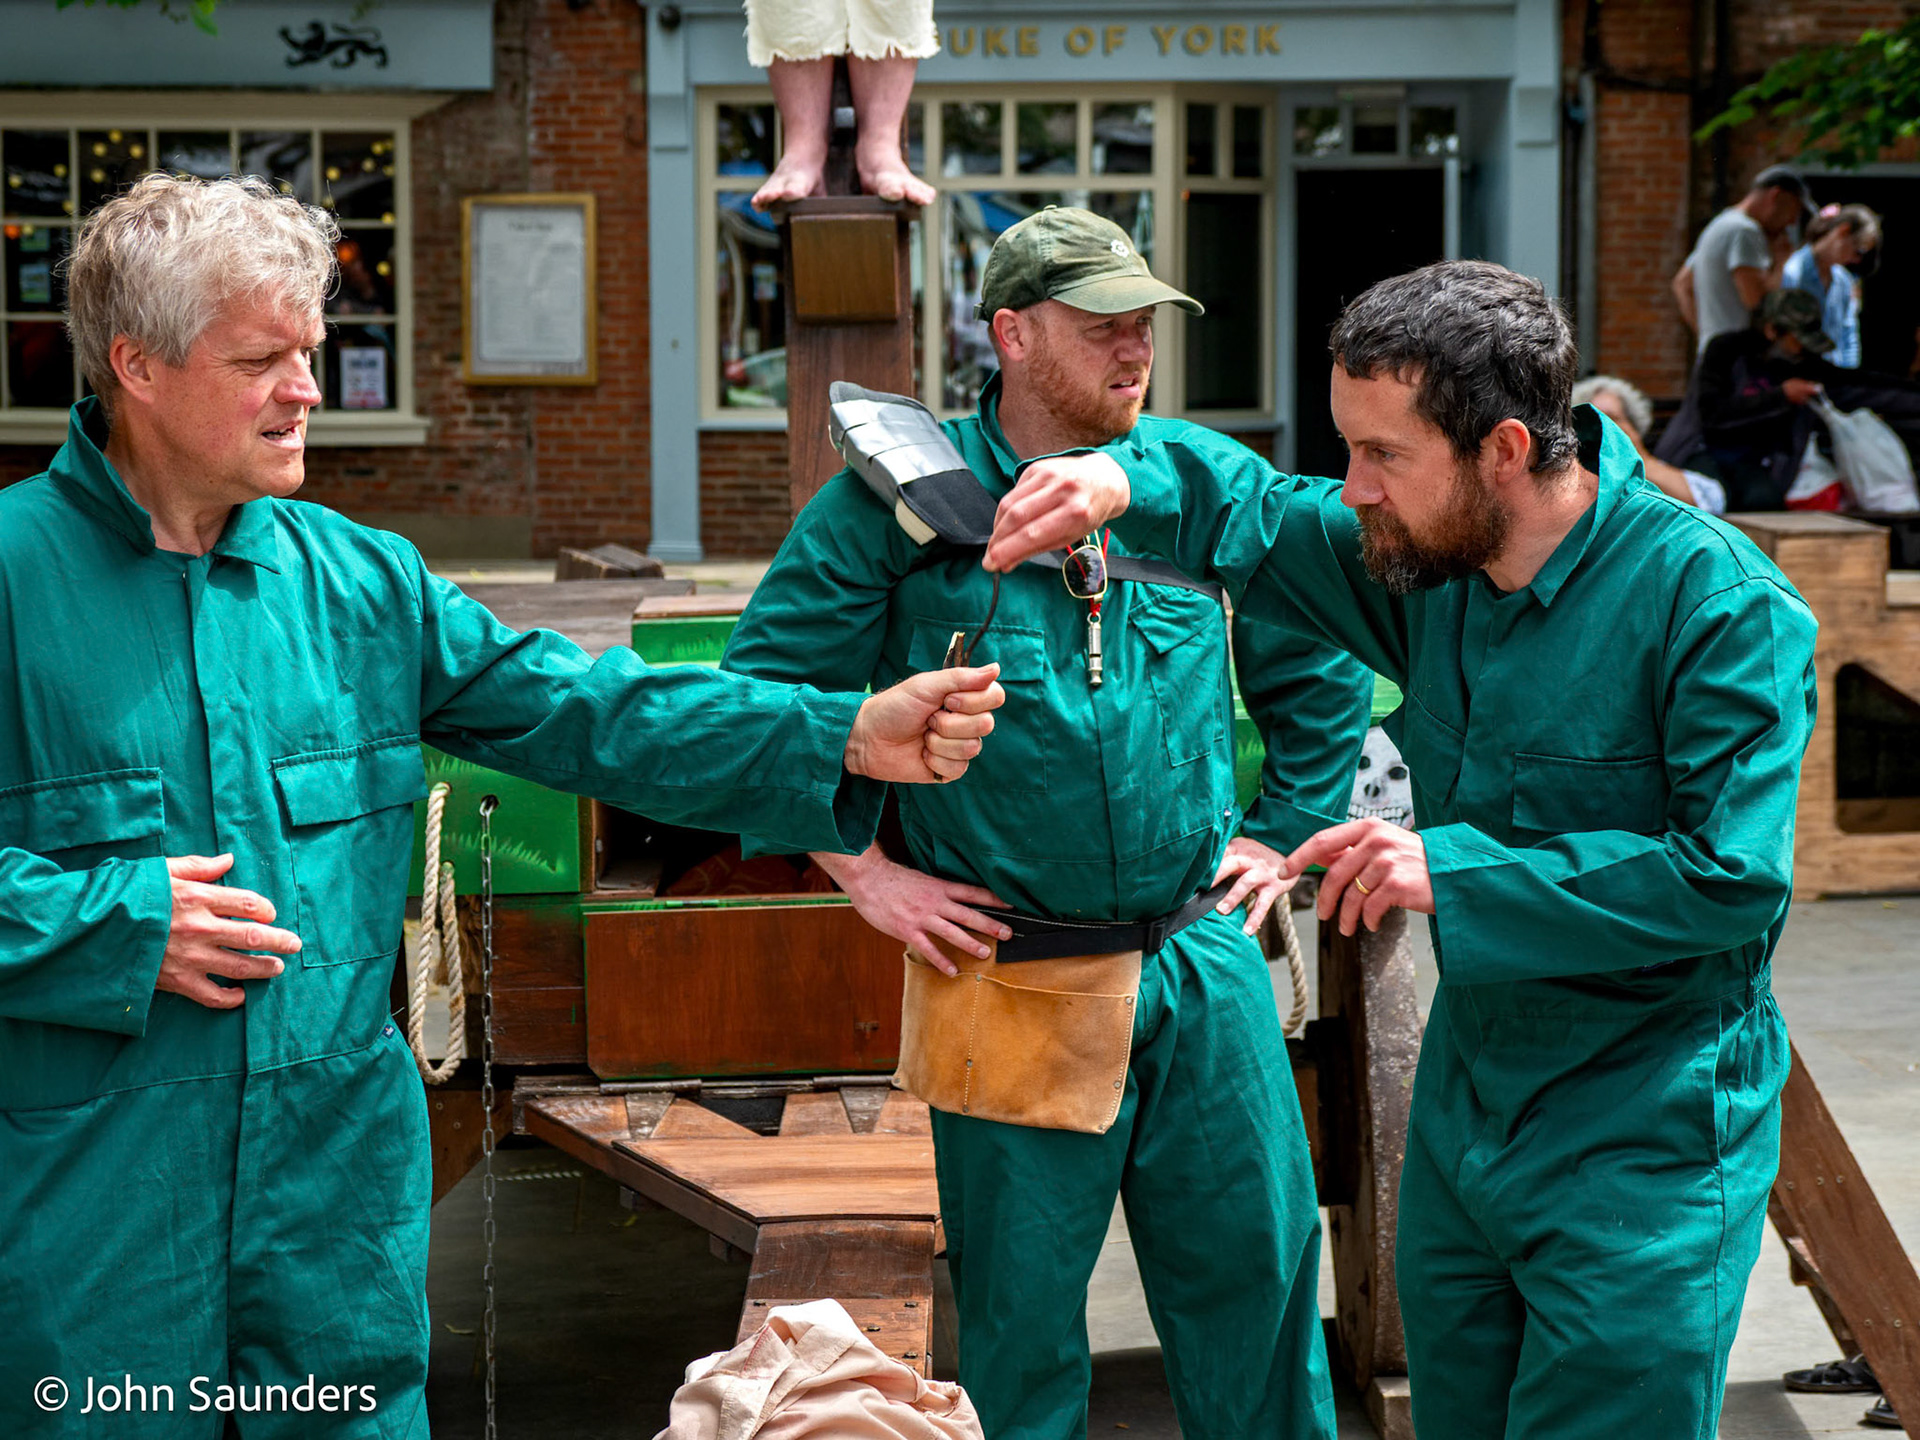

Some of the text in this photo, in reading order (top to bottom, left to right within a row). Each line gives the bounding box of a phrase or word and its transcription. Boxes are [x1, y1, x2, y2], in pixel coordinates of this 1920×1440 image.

[936, 25, 1282, 57] UKE OF YORK
